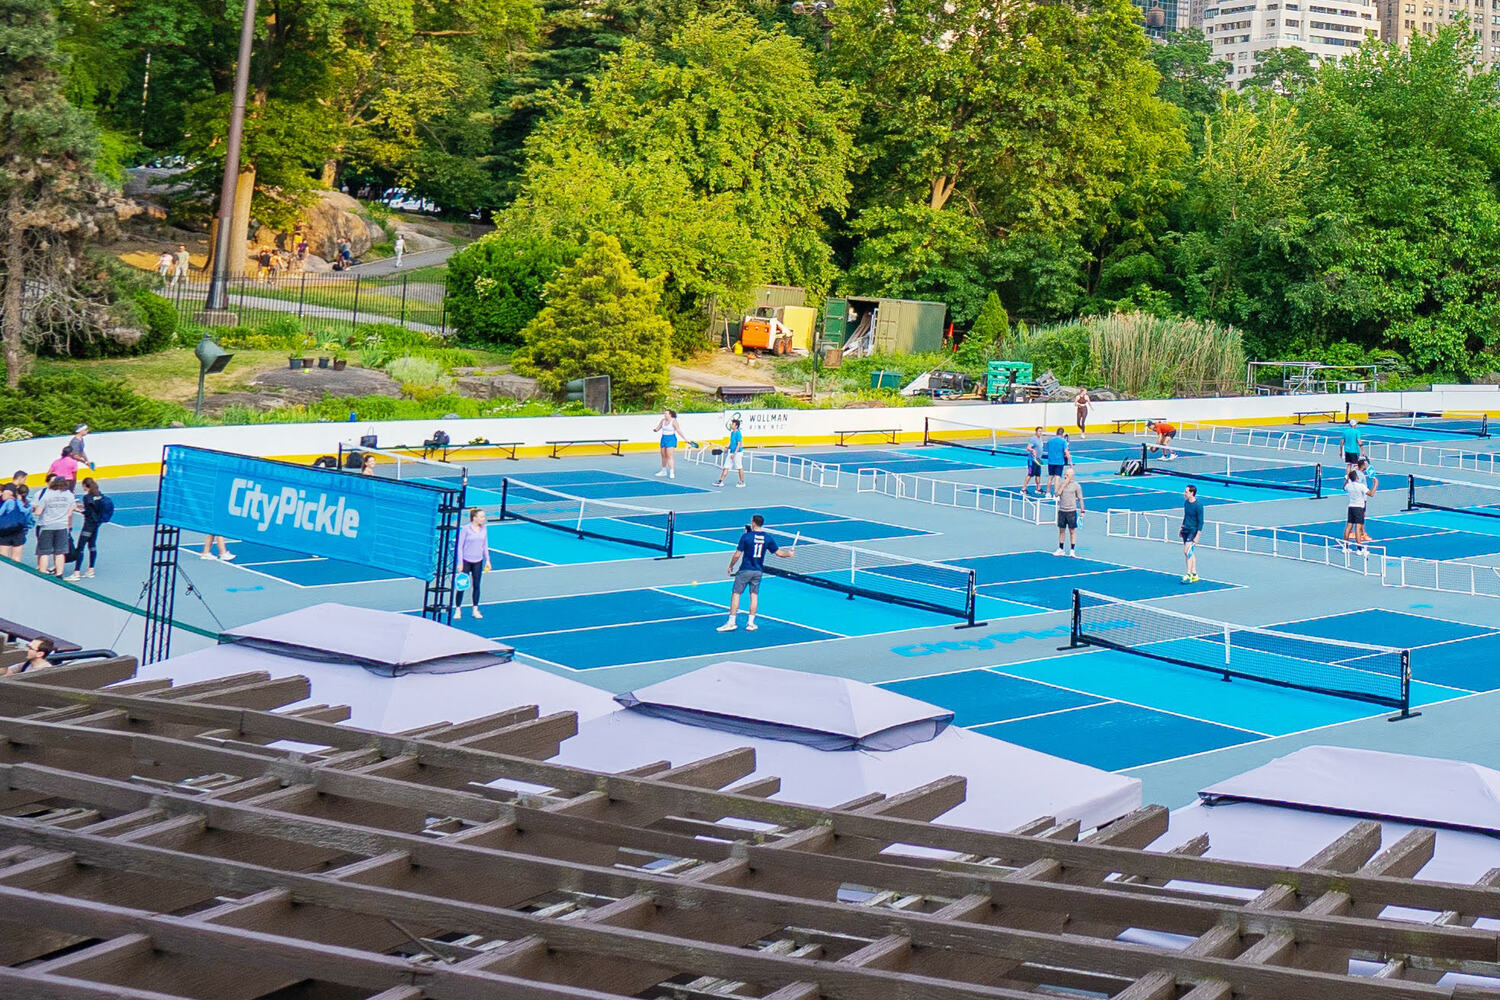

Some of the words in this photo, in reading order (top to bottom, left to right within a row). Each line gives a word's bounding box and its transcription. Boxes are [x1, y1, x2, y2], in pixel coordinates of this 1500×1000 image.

[749, 413, 789, 423] WOLLMAN
[228, 477, 360, 539] CityPickle
[753, 543, 763, 558] 11
